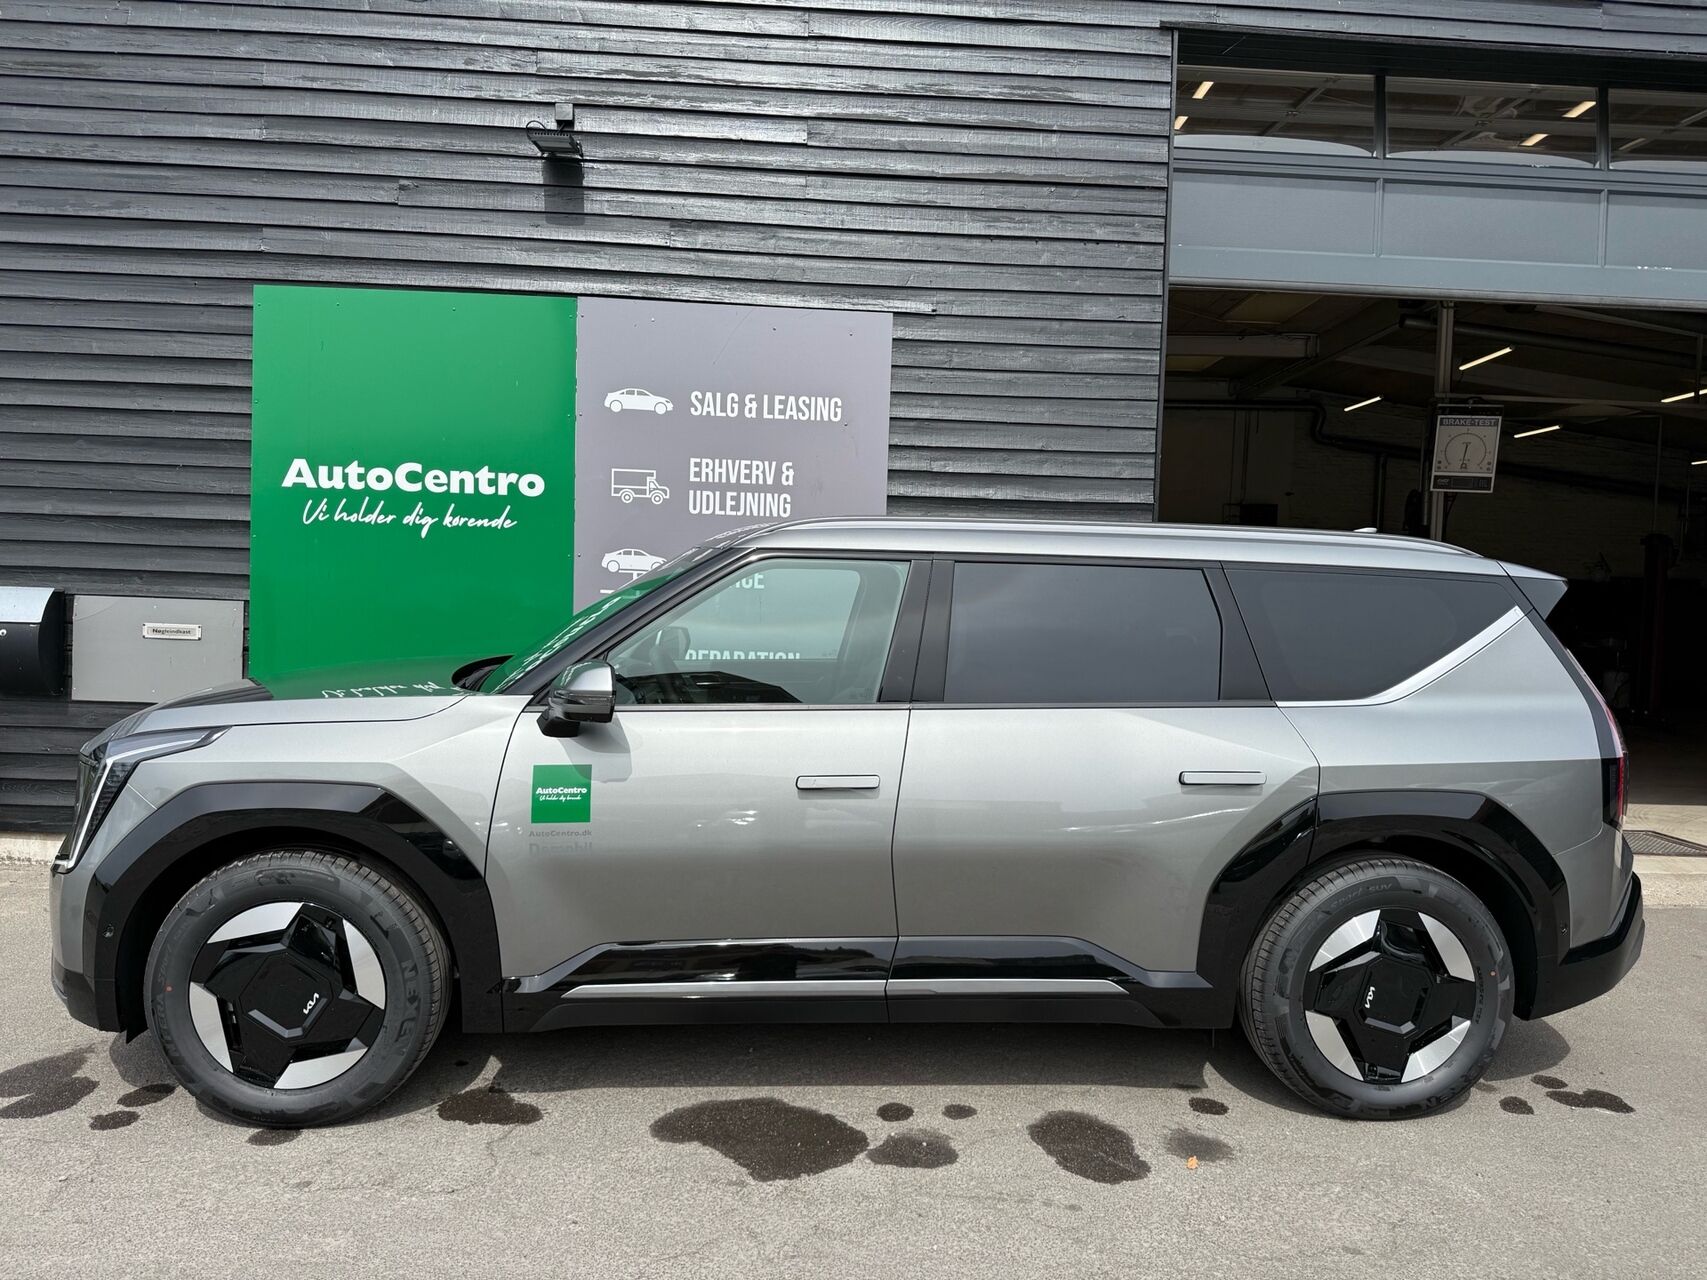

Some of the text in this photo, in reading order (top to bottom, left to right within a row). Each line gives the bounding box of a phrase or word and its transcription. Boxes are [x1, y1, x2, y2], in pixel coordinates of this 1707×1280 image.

[690, 391, 842, 422] SALG & LEASING
[281, 458, 546, 497] AutoCentro
[689, 457, 795, 486] ERHVERV &
[302, 498, 329, 525] Vi
[333, 496, 397, 526] holder
[402, 502, 439, 539] dig
[688, 490, 791, 518] UDLEJNING
